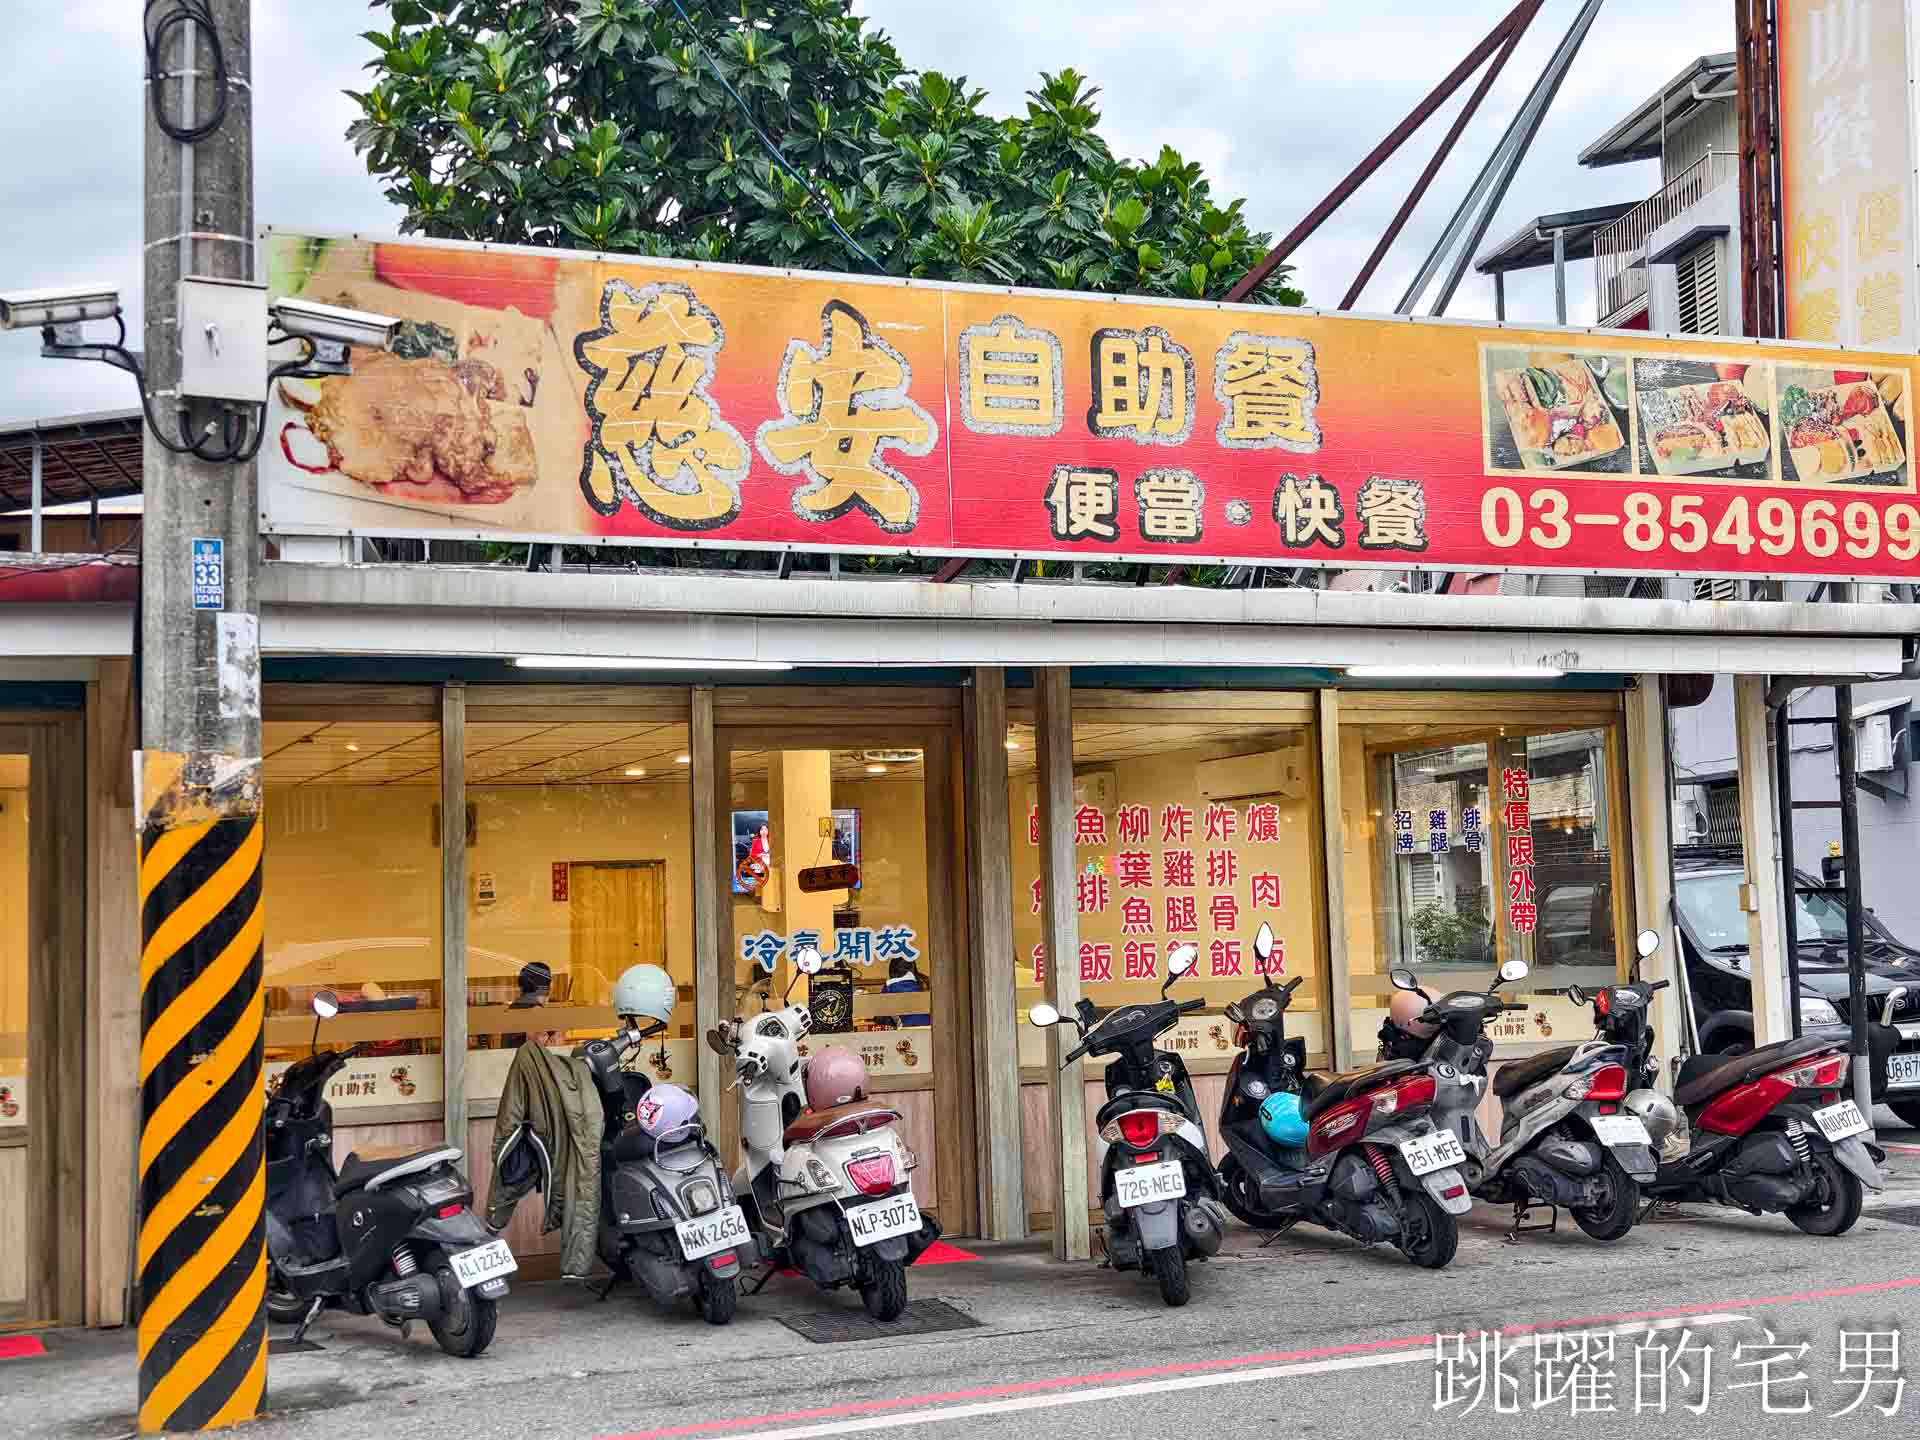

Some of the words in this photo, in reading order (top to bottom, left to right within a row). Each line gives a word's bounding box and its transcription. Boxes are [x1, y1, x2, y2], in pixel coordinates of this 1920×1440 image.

[964, 319, 1318, 448] 自助餐
[1481, 487, 1920, 560] 03-8549699
[196, 565, 220, 585] 33
[1394, 810, 1414, 853] 招牌
[1429, 809, 1449, 853] 雞腿
[1463, 808, 1482, 852] 排骨
[1503, 768, 1537, 934] 特價限外帶
[1075, 806, 1112, 981] 魚排飯
[1119, 805, 1157, 979] 柳葉魚飯
[1204, 804, 1242, 976] 炸排骨飯
[744, 929, 917, 968] 冷氣開放
